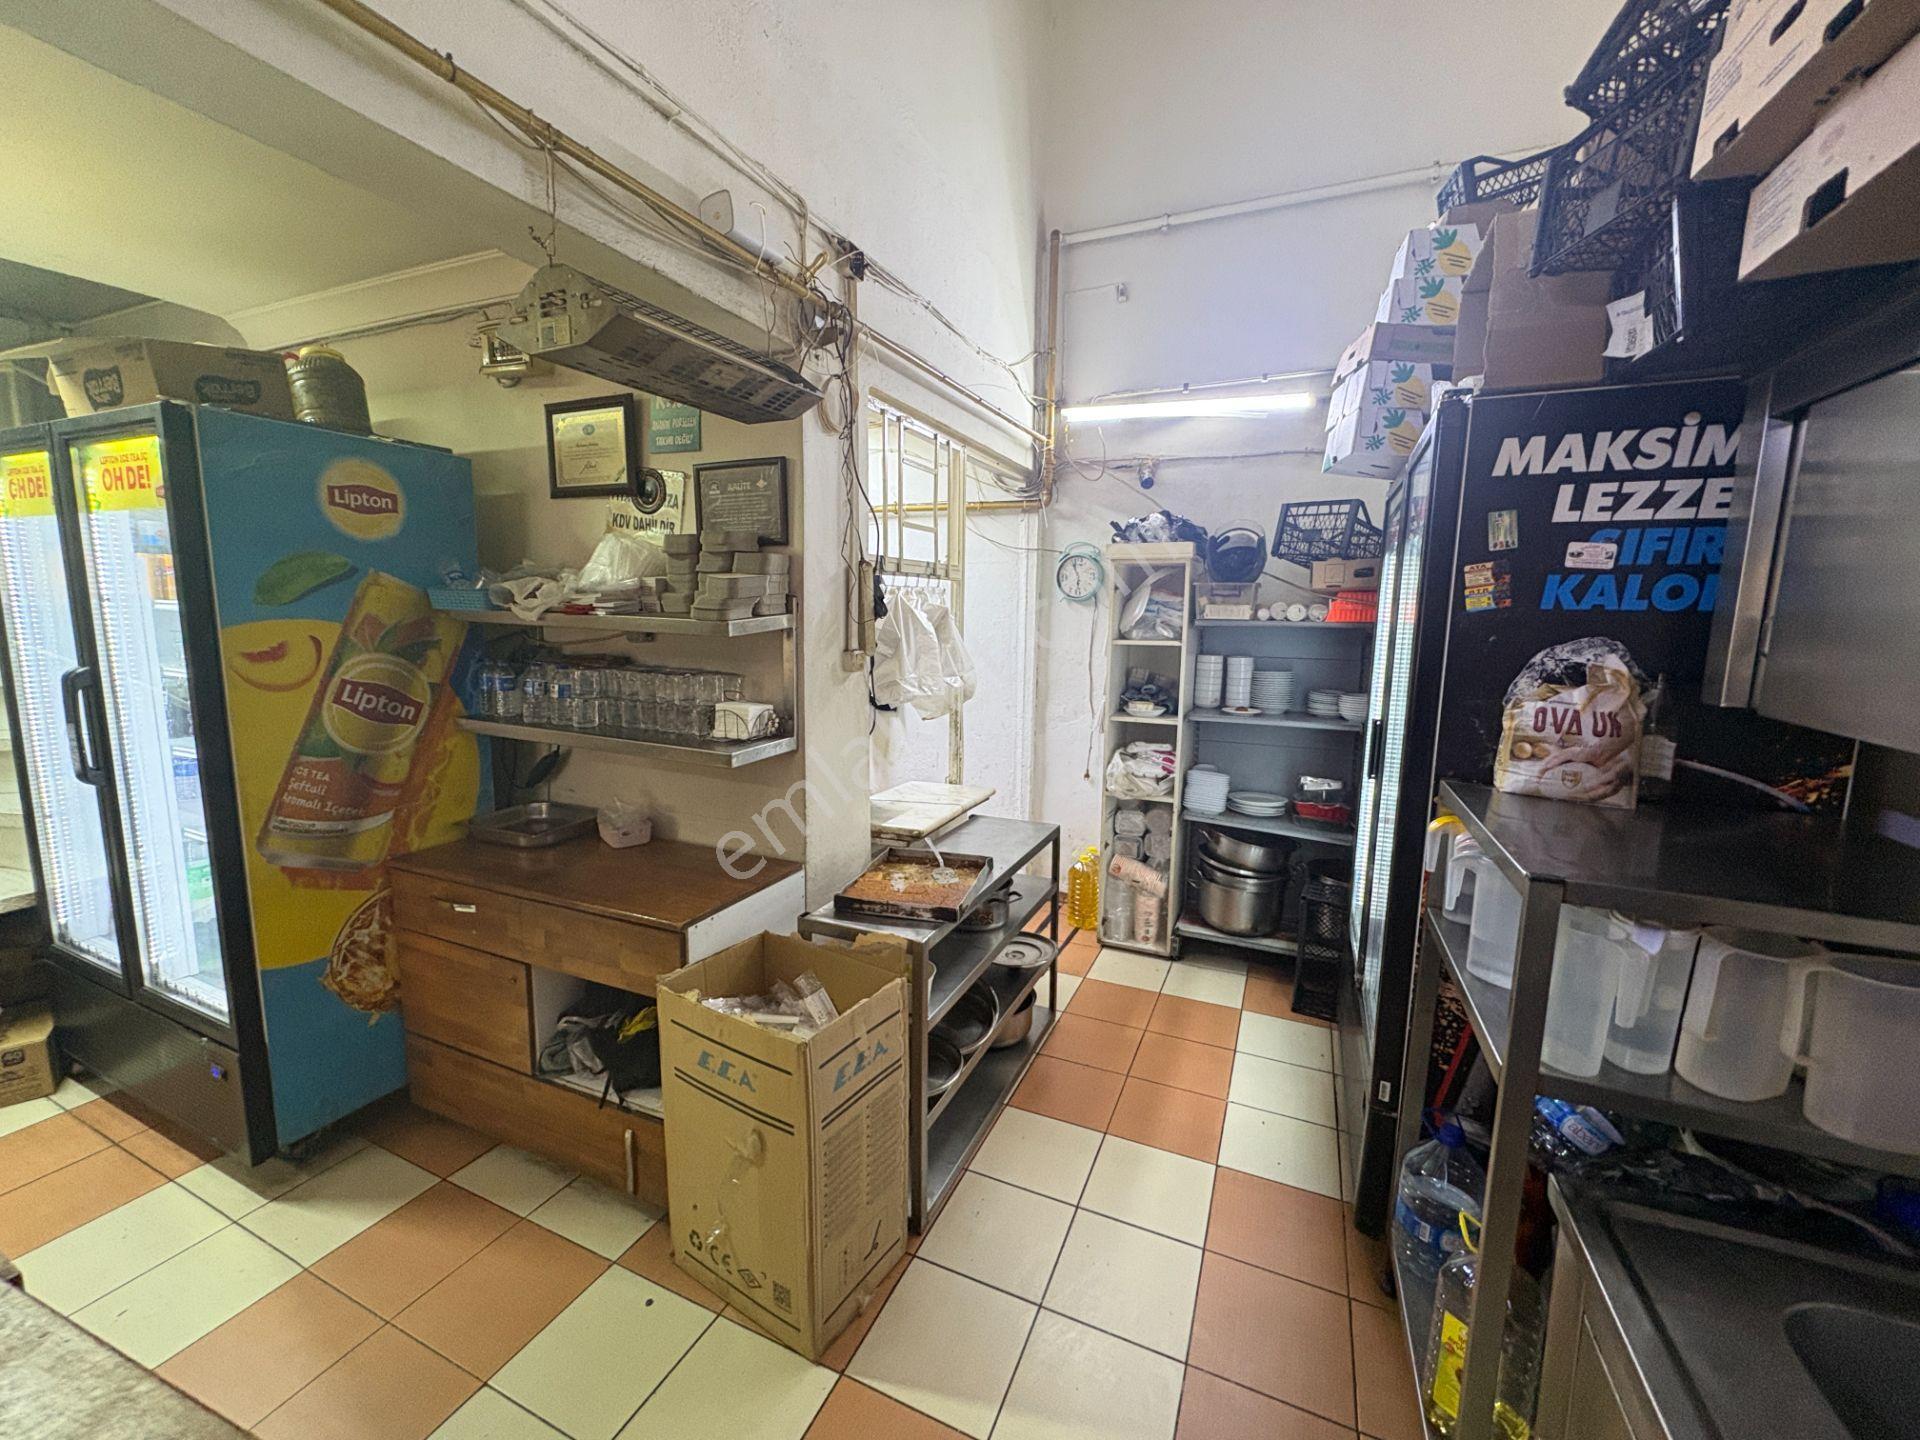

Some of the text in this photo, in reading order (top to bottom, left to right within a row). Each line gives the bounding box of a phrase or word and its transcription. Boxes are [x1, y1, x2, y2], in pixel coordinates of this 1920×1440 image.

[102, 465, 151, 491] OH DE!
[333, 488, 393, 510] Lipton
[1551, 477, 1735, 523] LEZZE
[612, 513, 676, 535] KDV DAHİLDİR
[341, 684, 416, 720] Lipton
[1533, 706, 1583, 736] OVA
[311, 769, 331, 782] TEA
